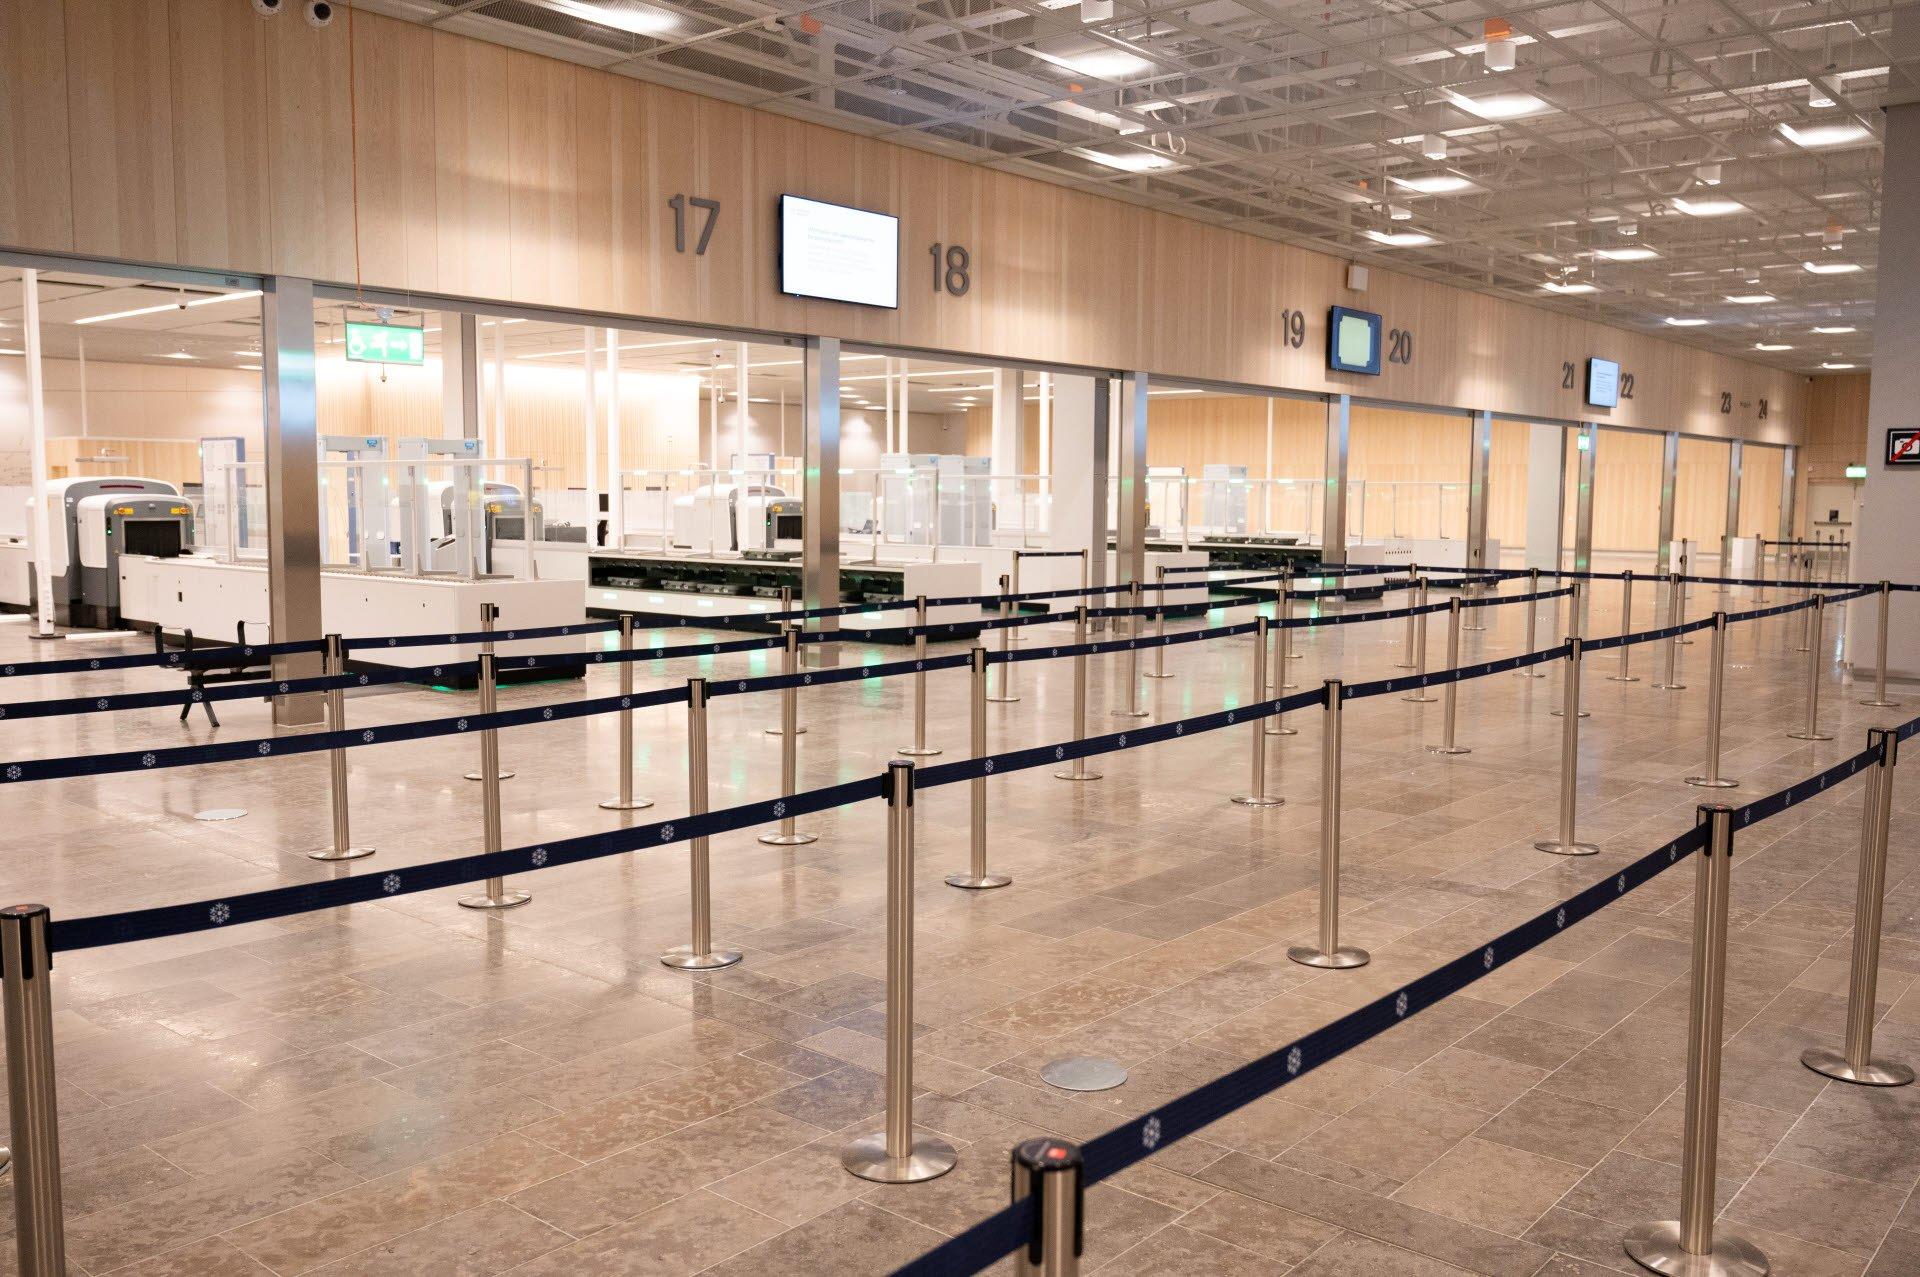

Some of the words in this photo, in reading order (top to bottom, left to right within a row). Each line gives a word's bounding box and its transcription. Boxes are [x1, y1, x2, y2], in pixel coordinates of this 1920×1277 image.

[669, 193, 721, 256] 17
[930, 242, 970, 296] 18
[1281, 308, 1305, 349] 19
[1389, 328, 1412, 364] 20
[1562, 361, 1575, 389] 21
[1621, 372, 1634, 399] 22
[1721, 391, 1732, 414] 23
[1758, 398, 1768, 419] 24
